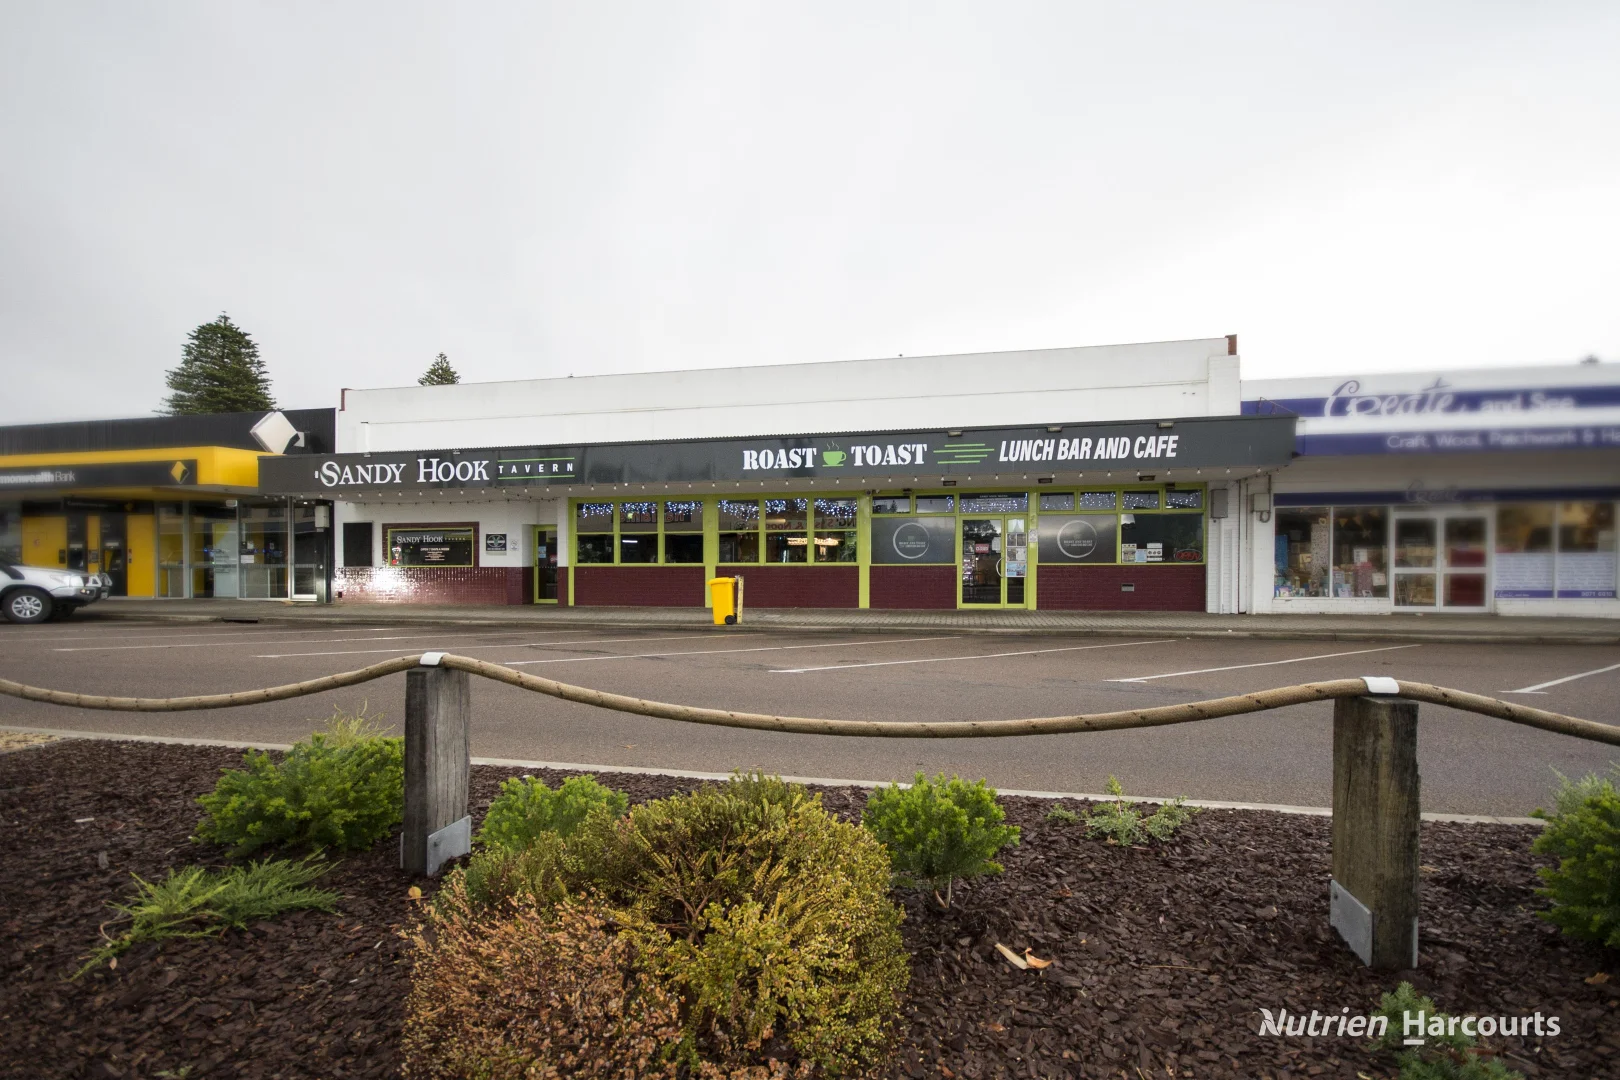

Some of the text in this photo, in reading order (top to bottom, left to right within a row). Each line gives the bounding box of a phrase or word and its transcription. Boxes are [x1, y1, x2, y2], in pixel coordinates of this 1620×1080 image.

[1324, 377, 1574, 417] Create and See
[1490, 430, 1577, 446] Patchwork
[743, 435, 1179, 470] ROAST TOAST LUNCH BAR AND CAFE
[55, 471, 76, 482] Bank
[320, 458, 574, 487] SANDY HOOK TAVERN
[396, 535, 421, 544] SANDY
[423, 534, 444, 543] HOOK
